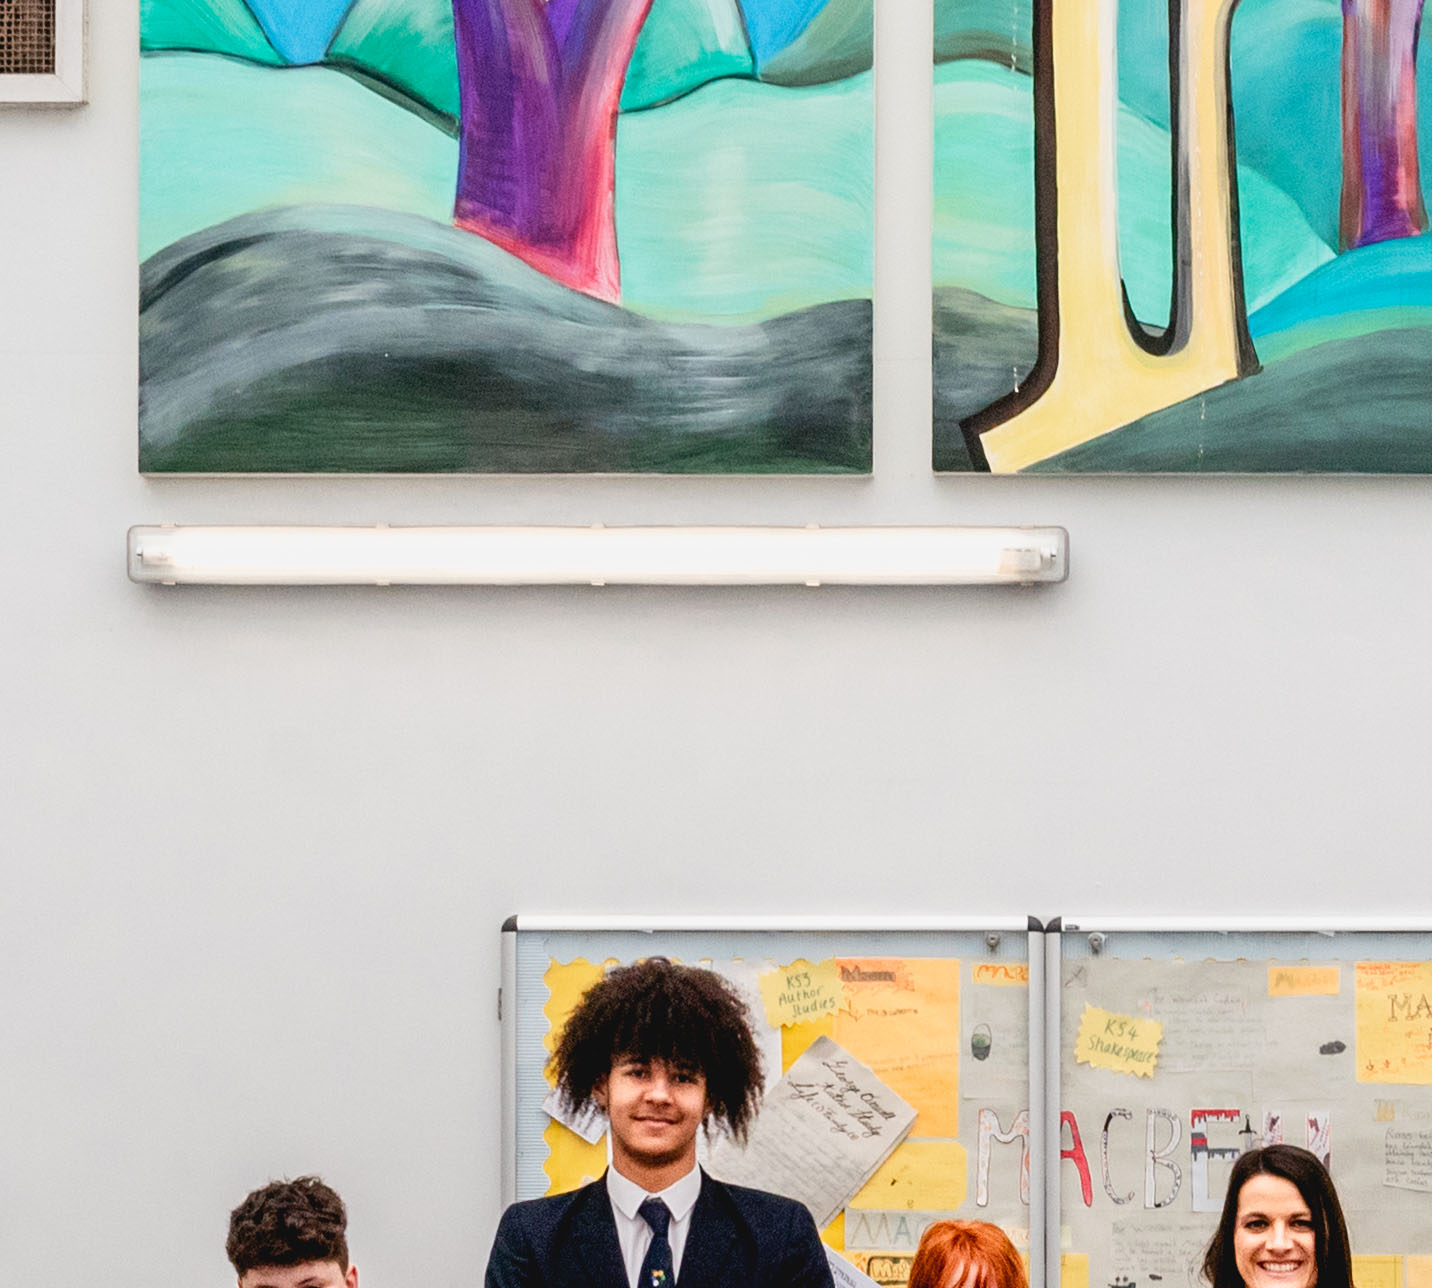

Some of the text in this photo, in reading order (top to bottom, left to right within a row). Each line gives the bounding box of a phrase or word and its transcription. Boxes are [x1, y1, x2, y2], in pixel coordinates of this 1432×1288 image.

[785, 971, 812, 990] KS3
[778, 985, 823, 1008] Author
[1103, 1017, 1140, 1041] KS4
